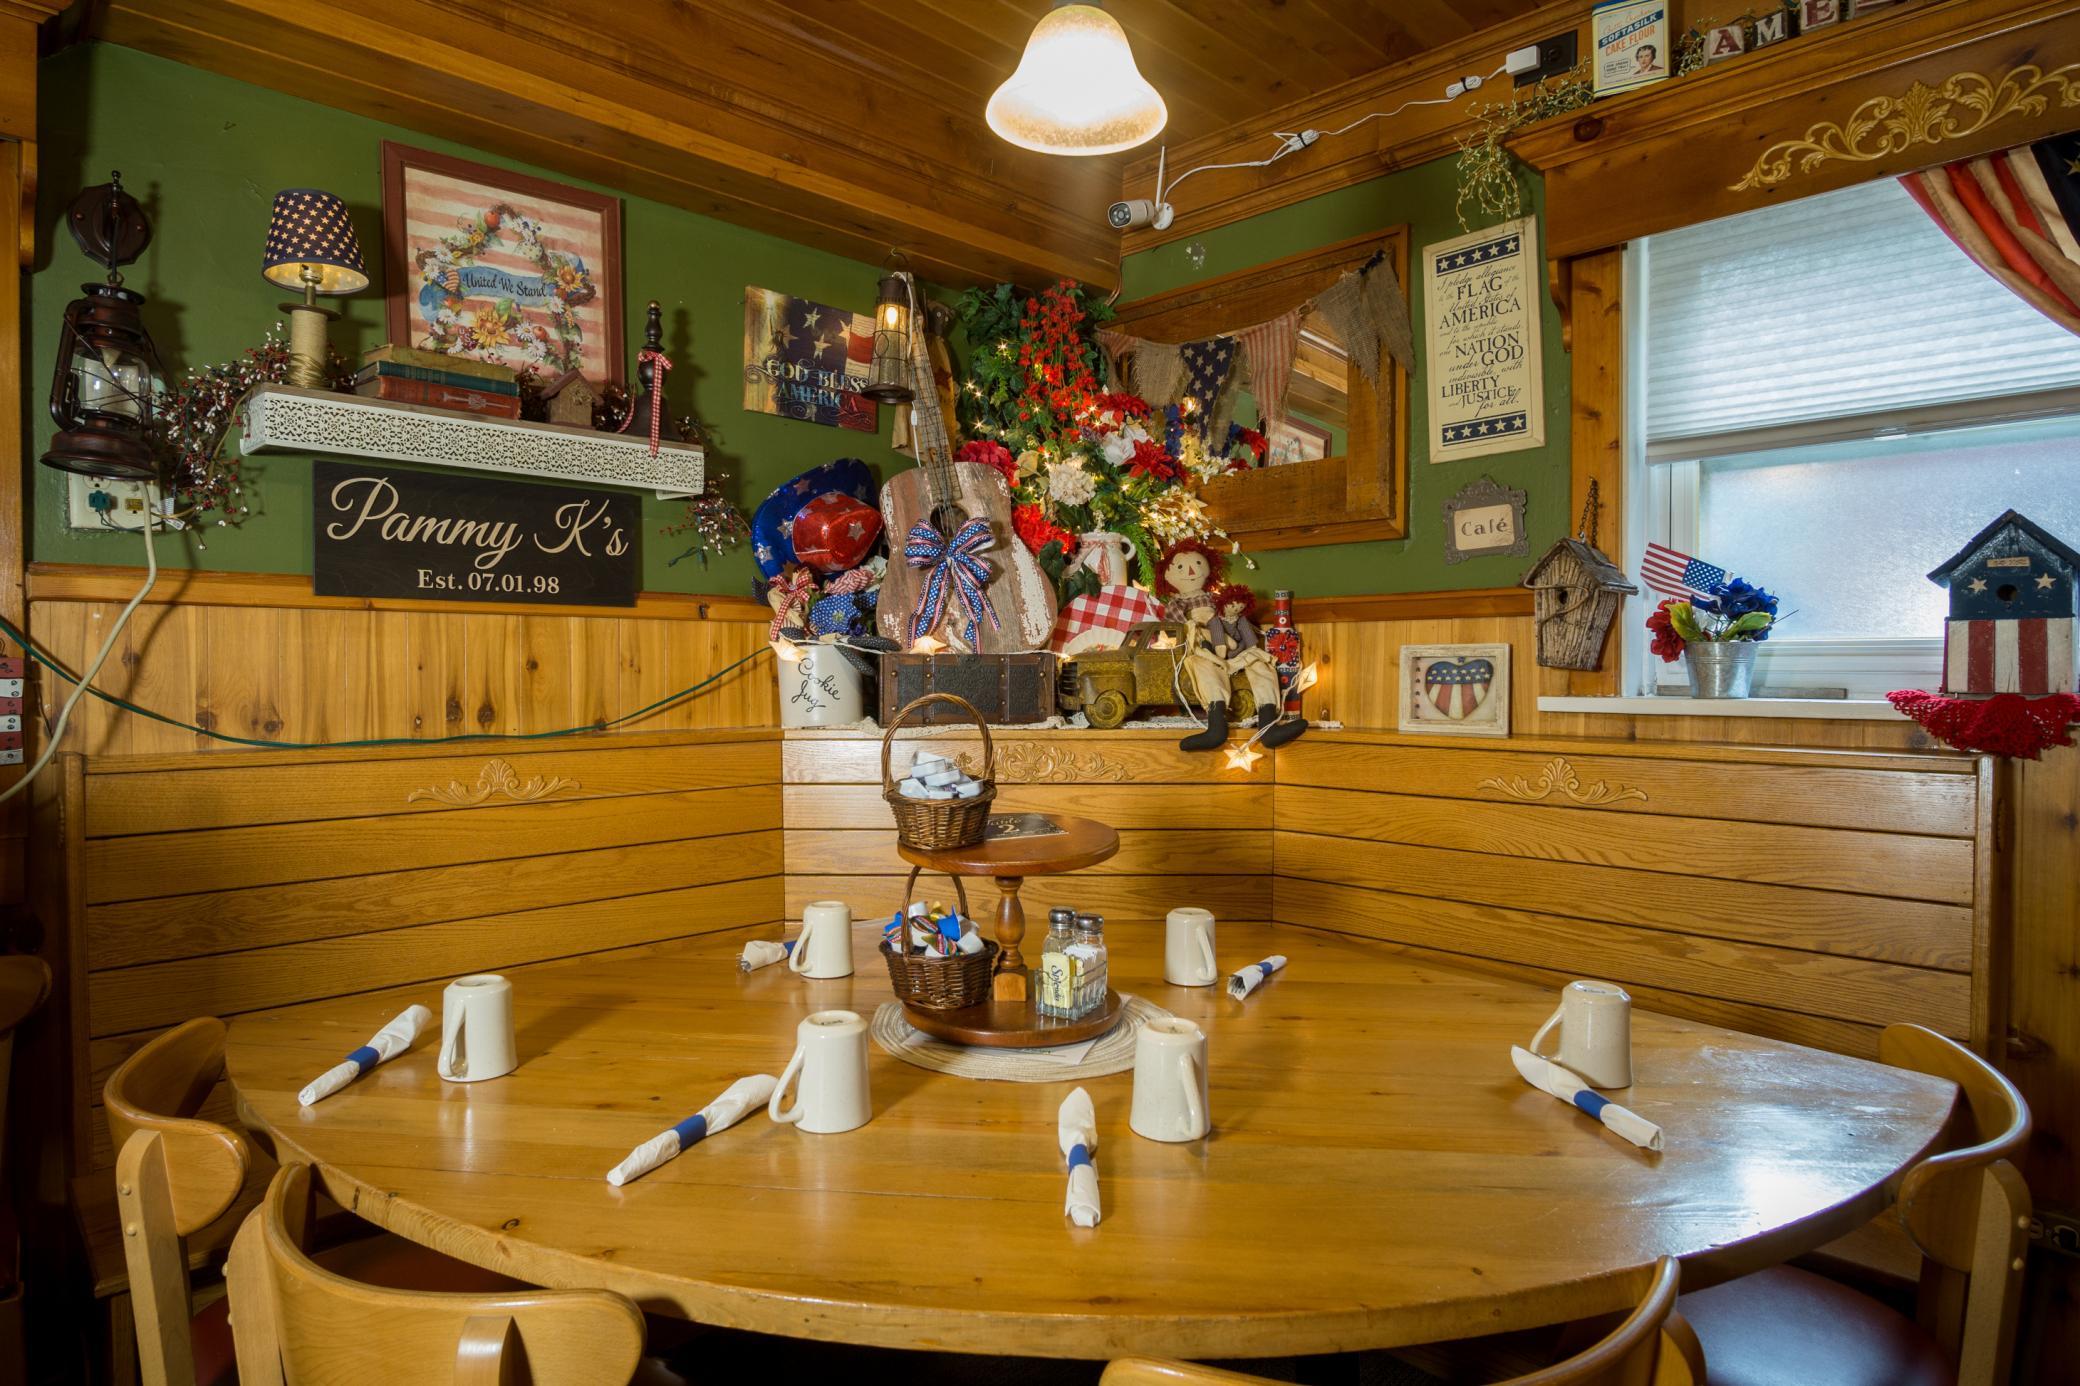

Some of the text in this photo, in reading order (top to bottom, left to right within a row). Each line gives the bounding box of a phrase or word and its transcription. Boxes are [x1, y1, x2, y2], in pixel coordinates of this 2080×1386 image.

[1601, 13, 1657, 46] SOFTASILK
[1605, 37, 1627, 57] CAKE
[1629, 25, 1656, 48] FLOUR
[462, 271, 547, 298] United We Stand
[1457, 276, 1503, 300] FLAG
[1439, 297, 1521, 330] AMERICA
[1455, 330, 1520, 358] NATION
[766, 358, 809, 383] GOD
[1448, 344, 1524, 372] under GOD
[1501, 357, 1525, 373] with
[777, 381, 858, 413] AMERICA
[1441, 374, 1501, 398] LIBERTY
[1461, 385, 1516, 409] JUSTICE
[1474, 395, 1494, 418] for
[326, 477, 629, 570] Pammy K's
[1461, 517, 1507, 537] Café
[417, 569, 560, 594] Est. 07.01.98
[797, 657, 840, 701] Cookie
[791, 679, 827, 713] Jug
[997, 823, 1020, 834] 2
[1050, 964, 1064, 1002] Splenda
